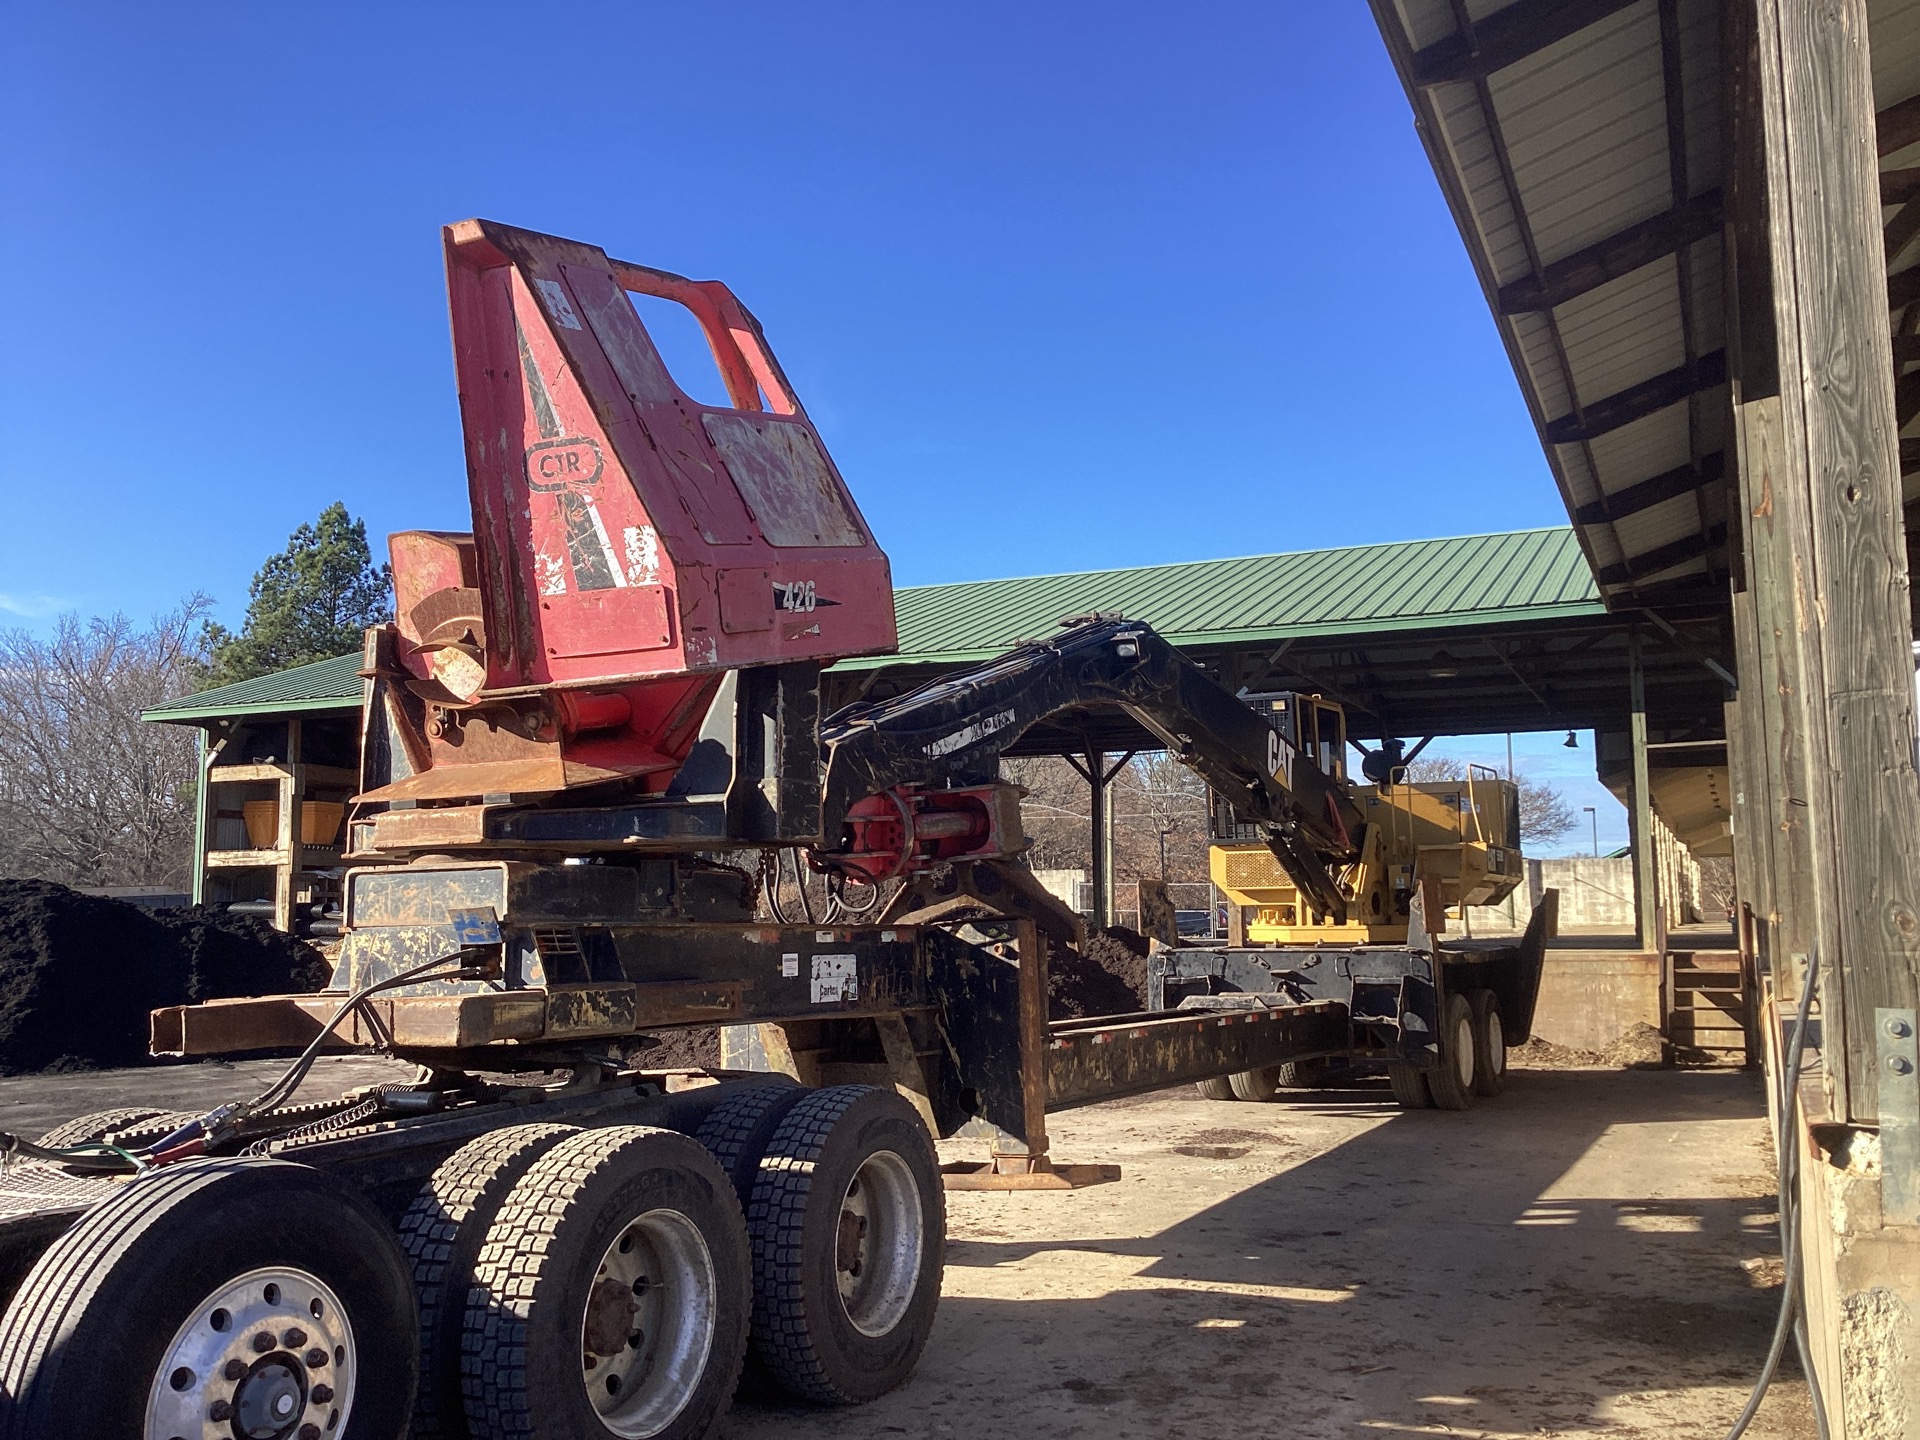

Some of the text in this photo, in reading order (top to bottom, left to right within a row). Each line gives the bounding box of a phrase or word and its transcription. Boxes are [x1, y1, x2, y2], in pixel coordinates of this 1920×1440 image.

[539, 452, 581, 477] CTR
[783, 580, 816, 613] 426
[1267, 729, 1295, 792] CAT
